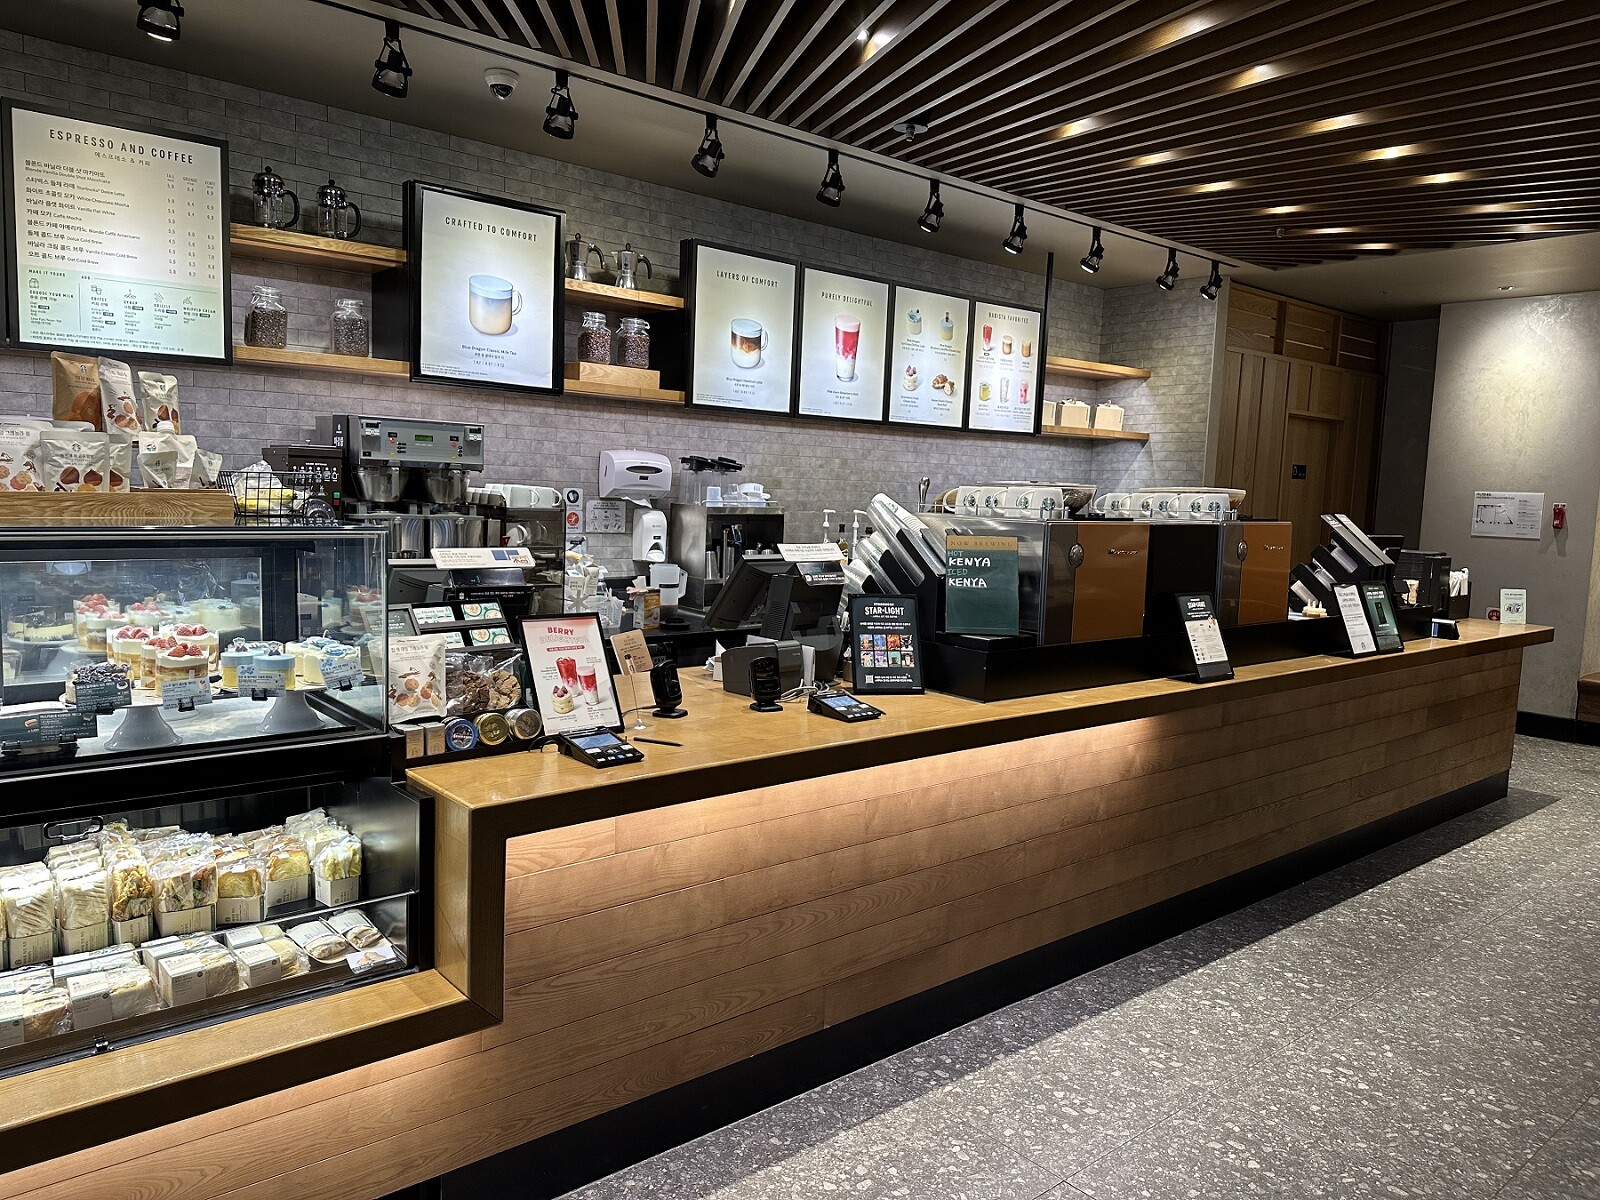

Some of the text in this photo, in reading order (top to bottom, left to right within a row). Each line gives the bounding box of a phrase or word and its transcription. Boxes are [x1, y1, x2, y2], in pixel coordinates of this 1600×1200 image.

[49, 129, 193, 164] ESPRESSO AND COFFEE
[25, 159, 42, 168] 블론드
[43, 163, 62, 171] 바닐라
[94, 151, 127, 162] 에스프레소
[138, 159, 151, 167] 커피
[25, 176, 49, 185] 스타벅스
[58, 223, 88, 233] 아메리카노
[445, 216, 537, 242] CRAFTED TO COMFORT
[716, 270, 740, 281] LAYERS
[751, 276, 778, 288] COMFORT
[821, 291, 873, 307] PURELY DELIGHTFUL
[988, 312, 1029, 324] BARISTA FAVORITES
[948, 557, 991, 567] KENYA
[948, 577, 987, 588] KENYA
[547, 627, 574, 635] BERRY
